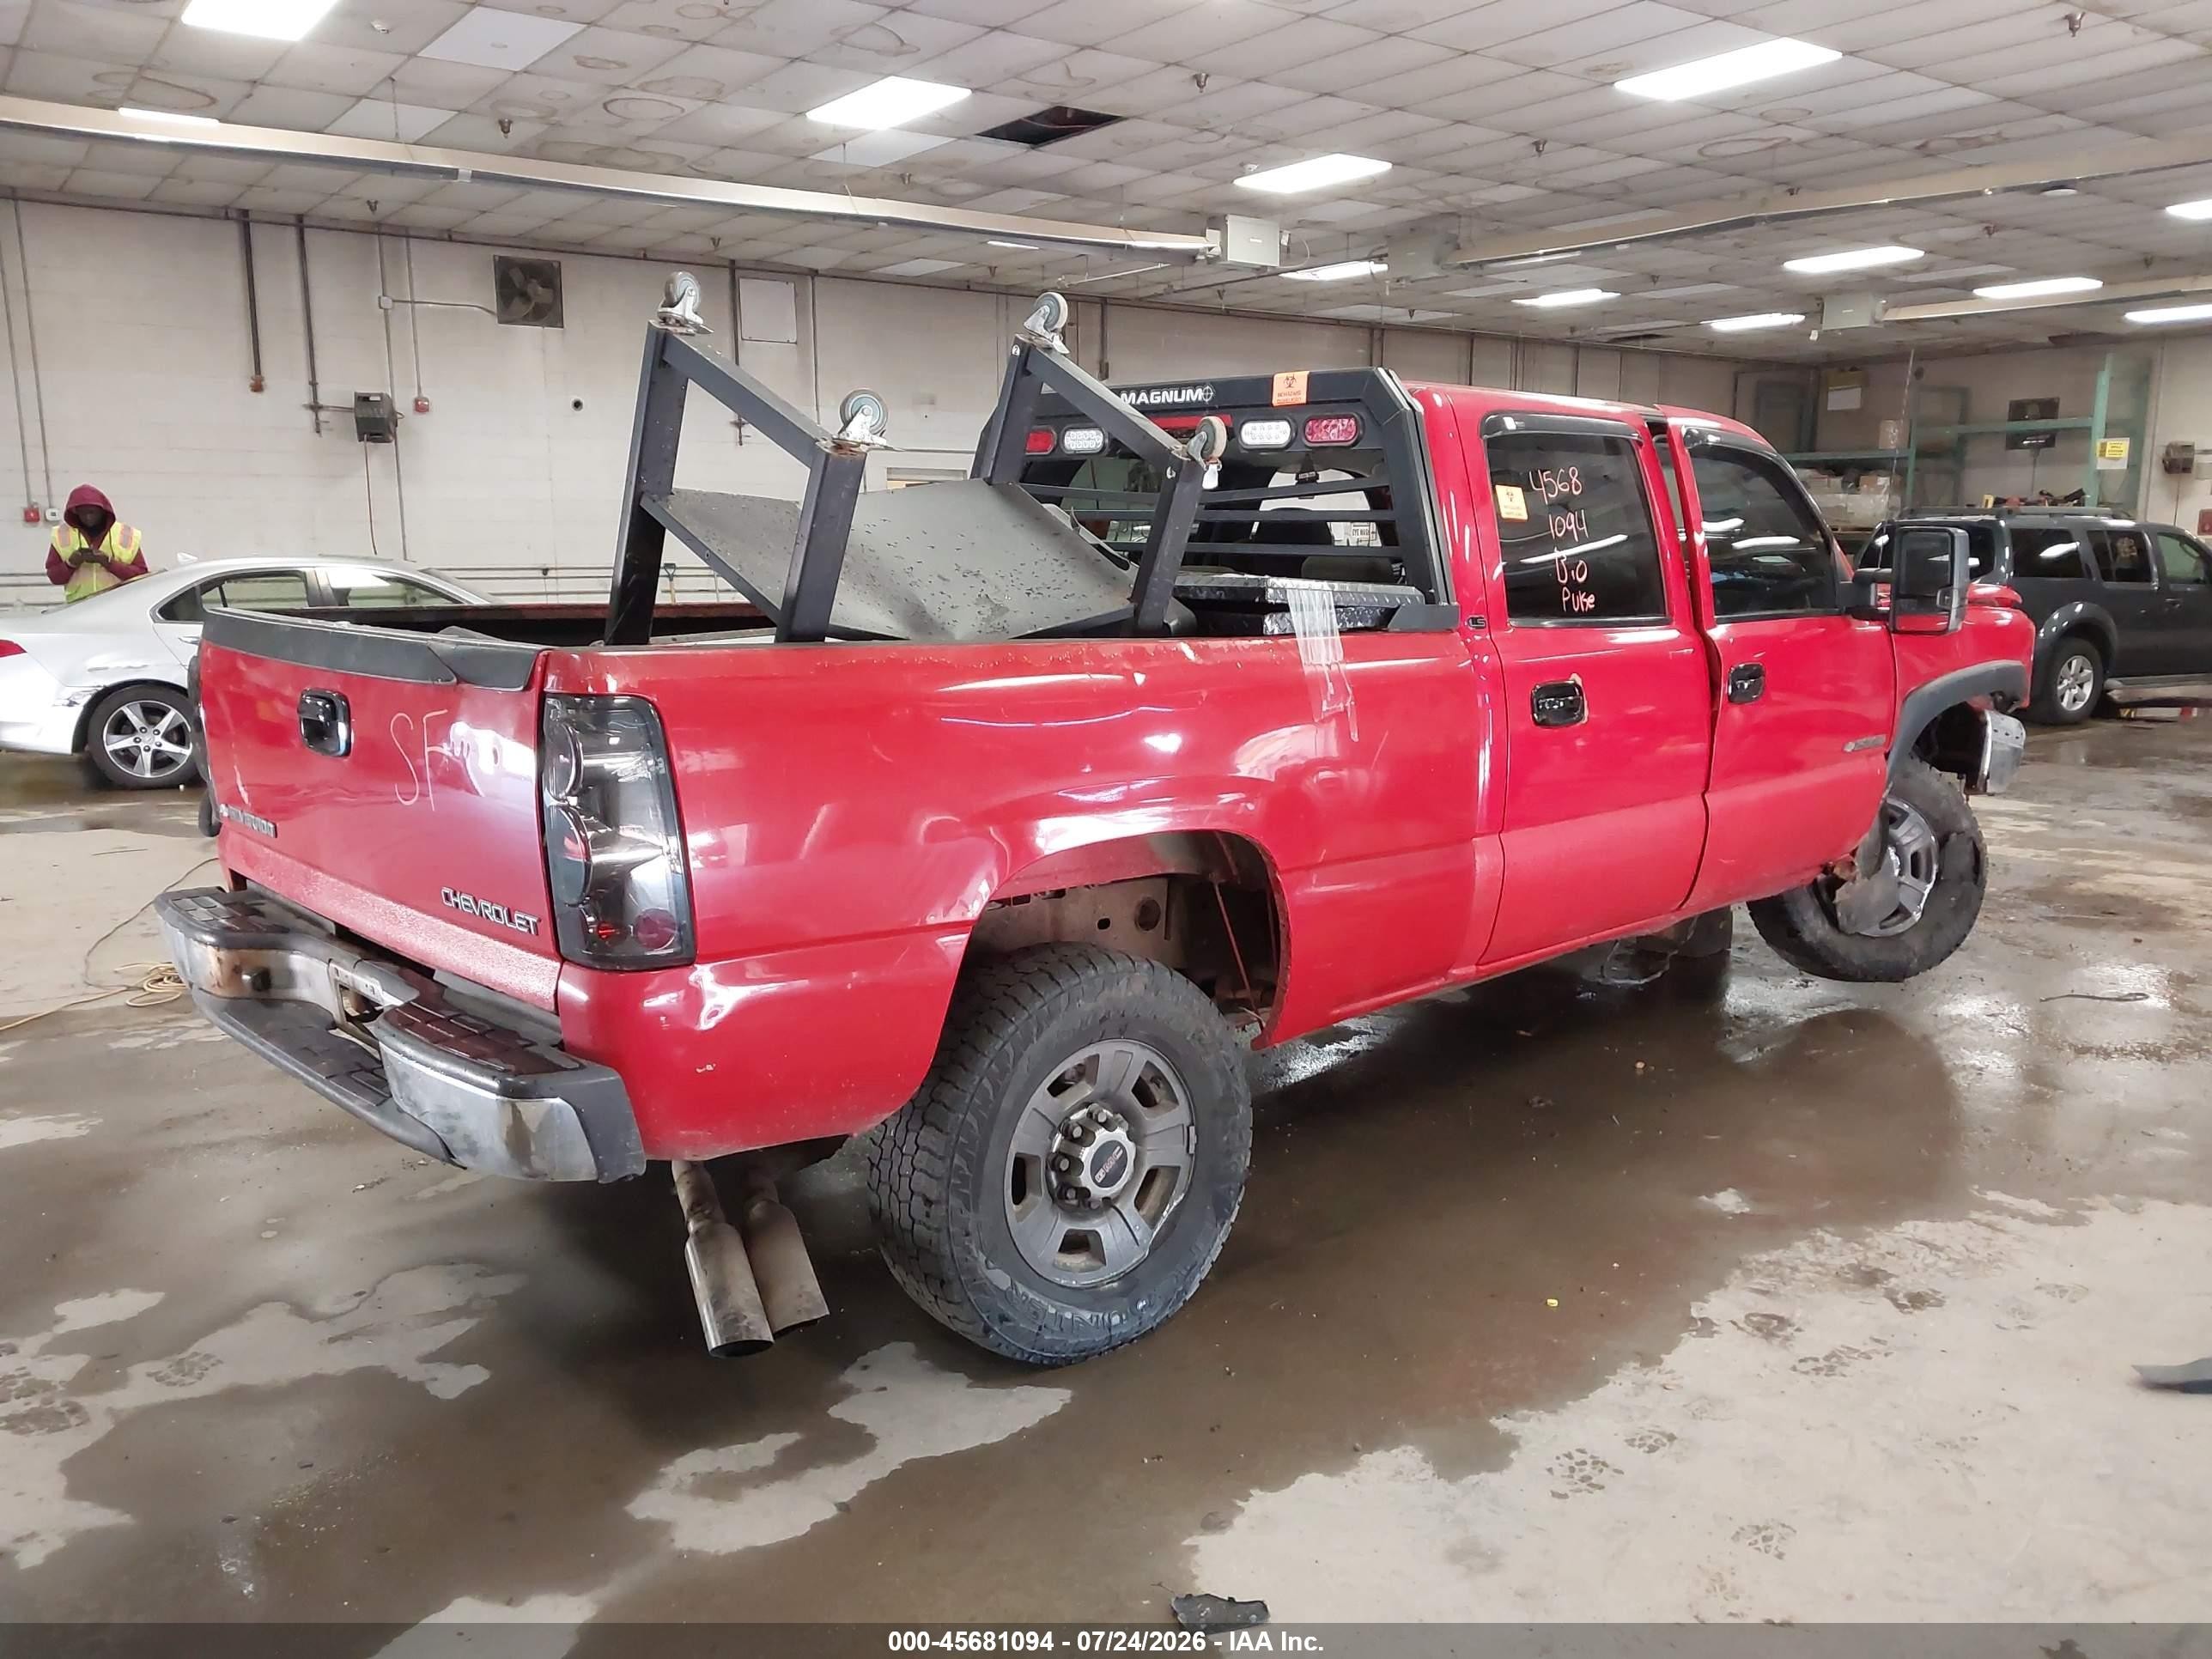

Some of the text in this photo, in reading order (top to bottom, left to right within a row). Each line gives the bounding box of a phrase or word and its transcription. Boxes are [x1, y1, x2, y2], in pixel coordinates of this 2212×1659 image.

[1120, 386, 1203, 405] MAGNUM
[1529, 466, 1583, 505] 4568
[1549, 508, 1589, 542] 1094
[441, 886, 540, 935] CHEVROLET
